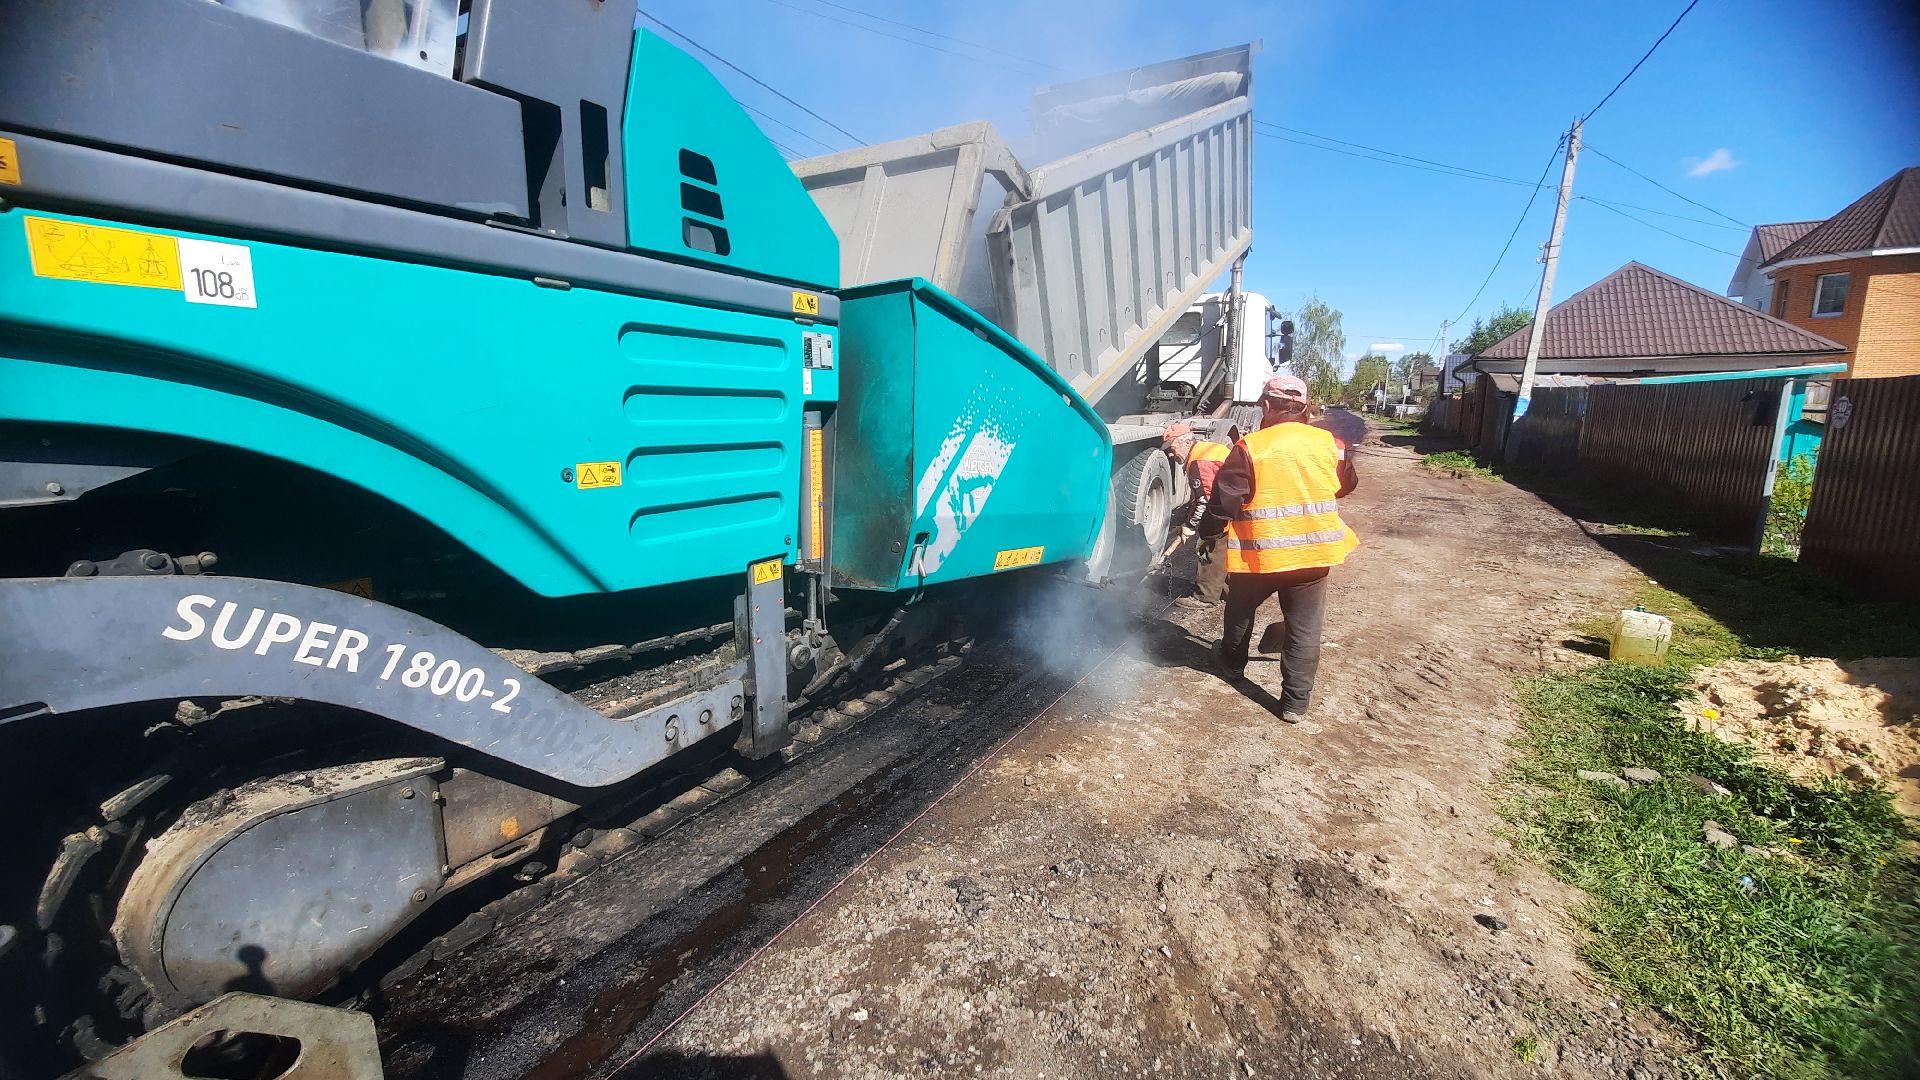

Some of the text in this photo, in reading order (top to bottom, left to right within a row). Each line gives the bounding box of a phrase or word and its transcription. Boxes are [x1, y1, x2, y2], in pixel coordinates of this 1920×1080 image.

[190, 267, 235, 299] 108
[162, 594, 521, 714] SUPER 1800-2
